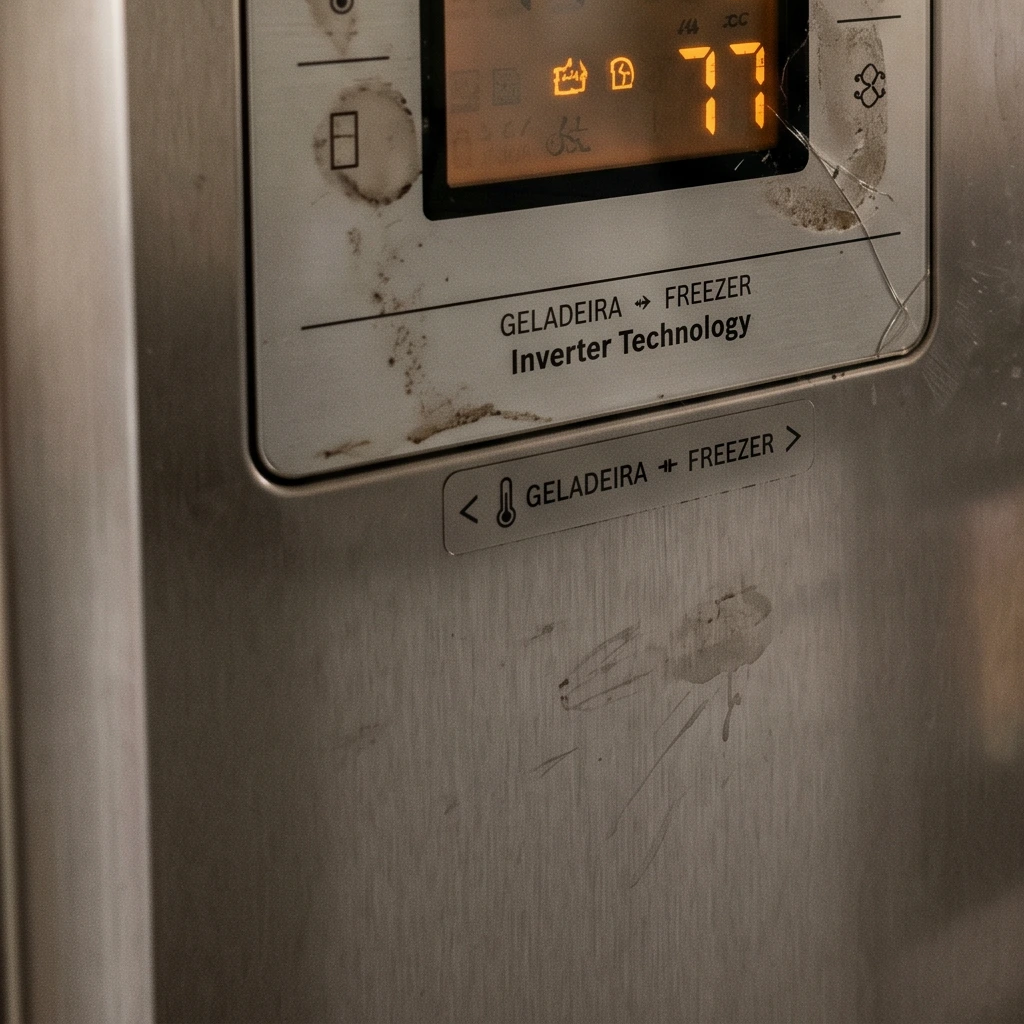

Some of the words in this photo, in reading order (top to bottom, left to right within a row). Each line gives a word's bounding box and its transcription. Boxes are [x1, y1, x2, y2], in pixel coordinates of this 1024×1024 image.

[678, 41, 765, 136] 77
[500, 295, 623, 337] GELADEIRA
[664, 274, 752, 309] FREEZER
[511, 338, 612, 375] Inverter
[618, 313, 752, 356] Technology
[525, 460, 648, 508] GELADEIRA
[687, 432, 775, 472] FREEZER
